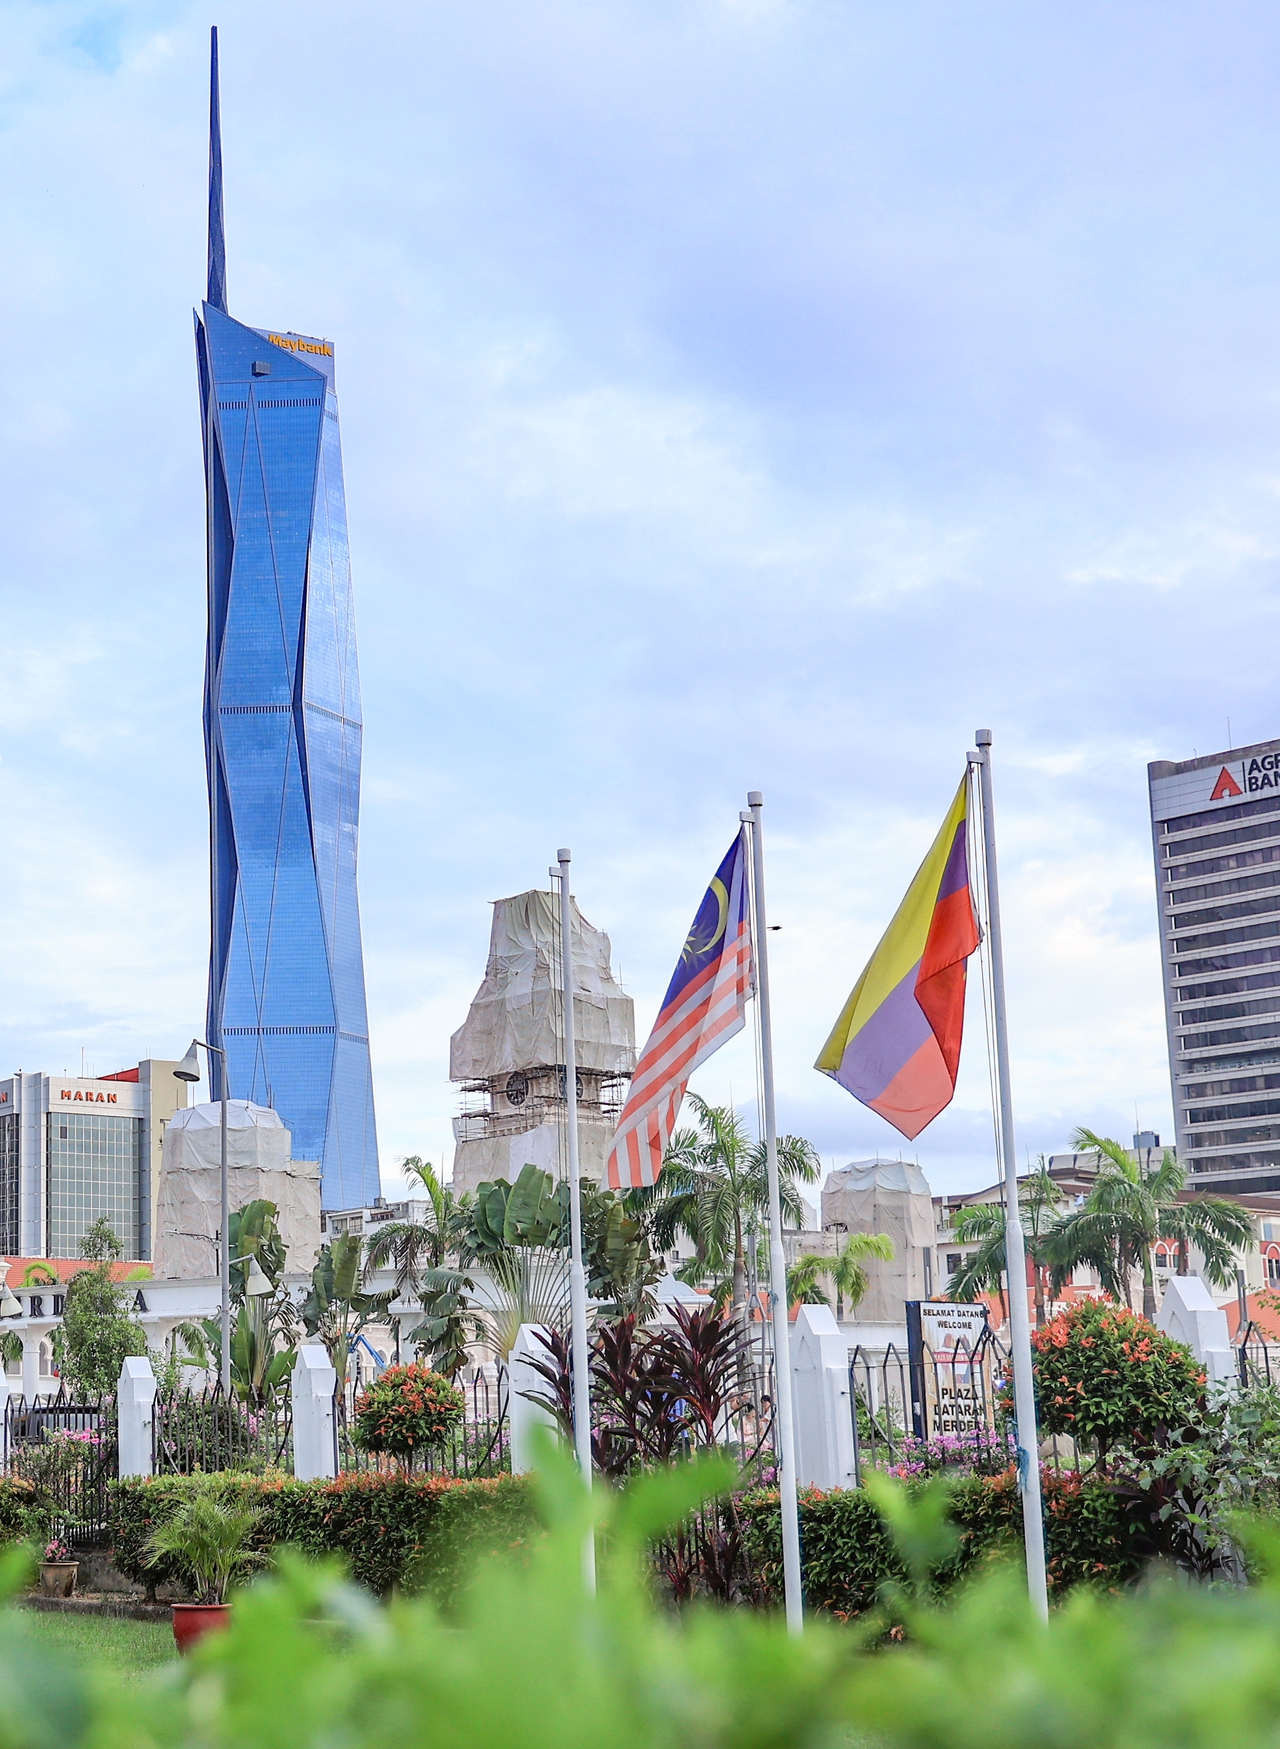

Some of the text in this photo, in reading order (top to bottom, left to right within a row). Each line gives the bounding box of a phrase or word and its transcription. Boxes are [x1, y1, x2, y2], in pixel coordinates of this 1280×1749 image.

[268, 334, 333, 357] Maybank
[61, 1089, 118, 1104] MARAN
[923, 1308, 955, 1317] SELAMAT
[937, 1320, 972, 1329] WELCOME
[941, 1388, 978, 1400] PLAZA
